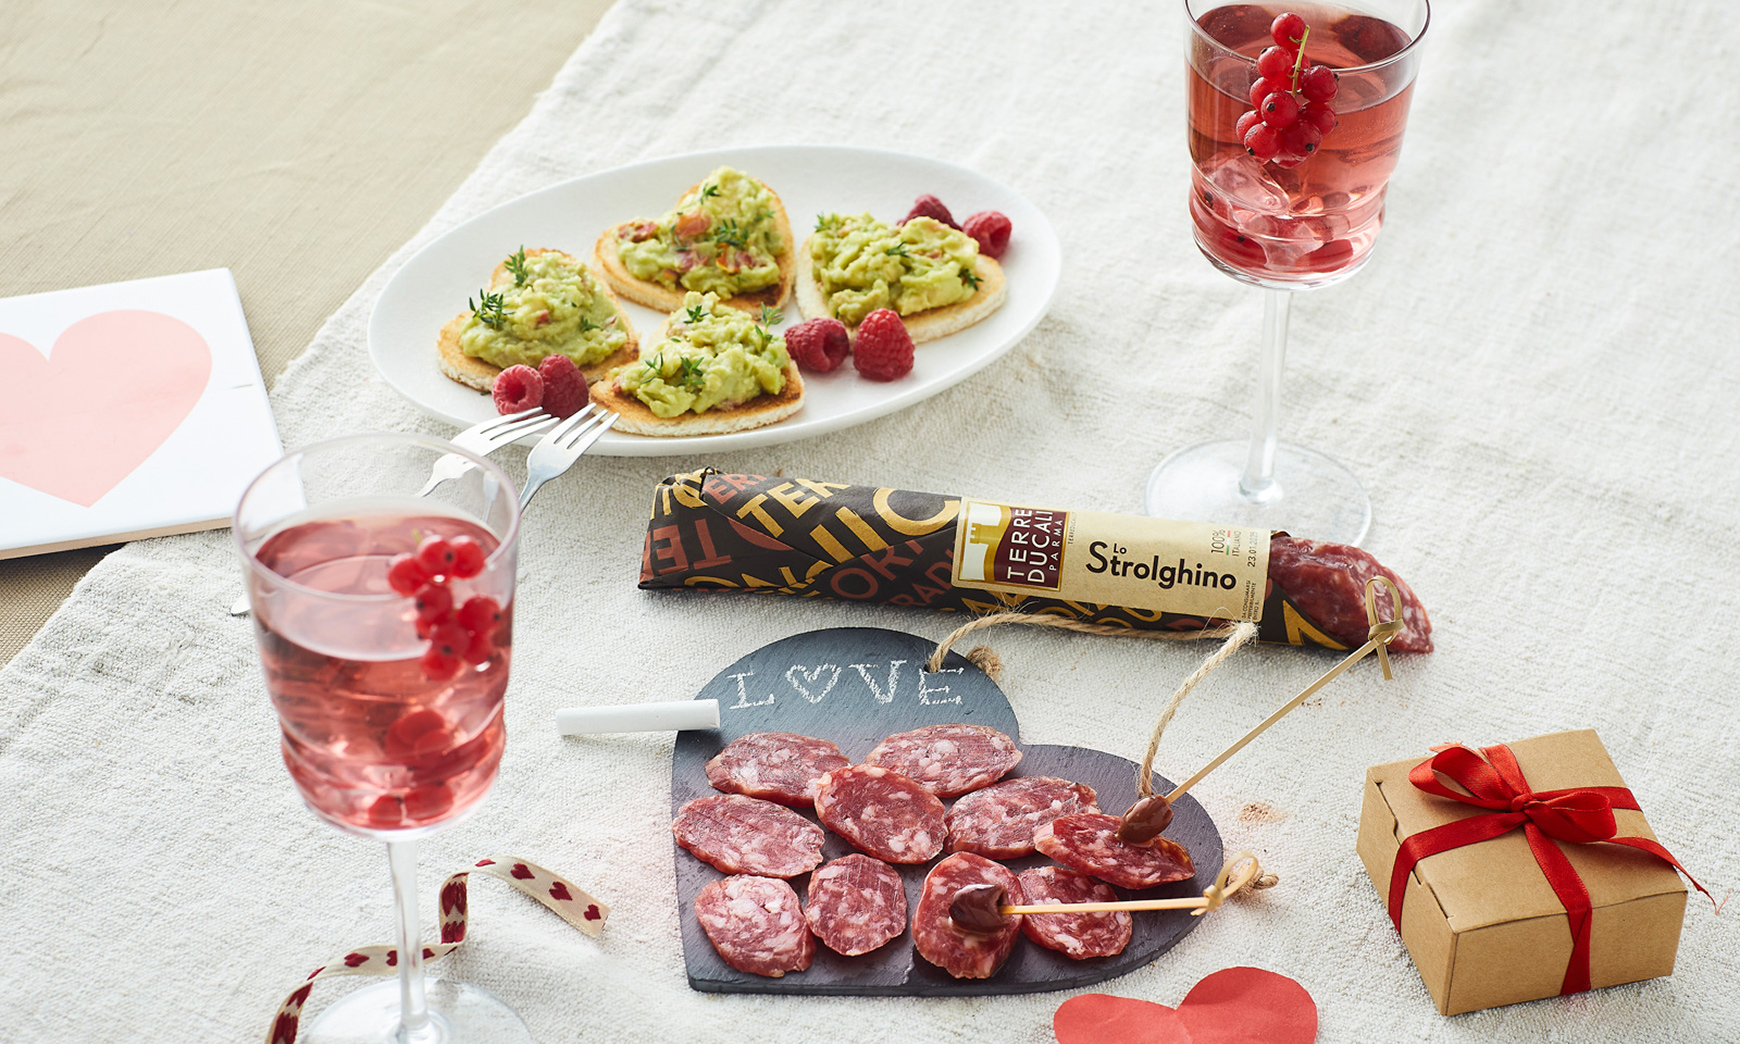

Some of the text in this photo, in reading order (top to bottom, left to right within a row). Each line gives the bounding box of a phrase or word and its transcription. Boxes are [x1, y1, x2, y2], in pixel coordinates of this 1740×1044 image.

[1007, 509, 1032, 579] TERRE
[1027, 510, 1053, 583] DUCALI
[1048, 520, 1063, 571] PARMA
[1113, 543, 1127, 554] Lo
[1211, 528, 1226, 553] 100%
[1232, 530, 1241, 557] ITALIANO
[1085, 541, 1237, 590] Strolghino
